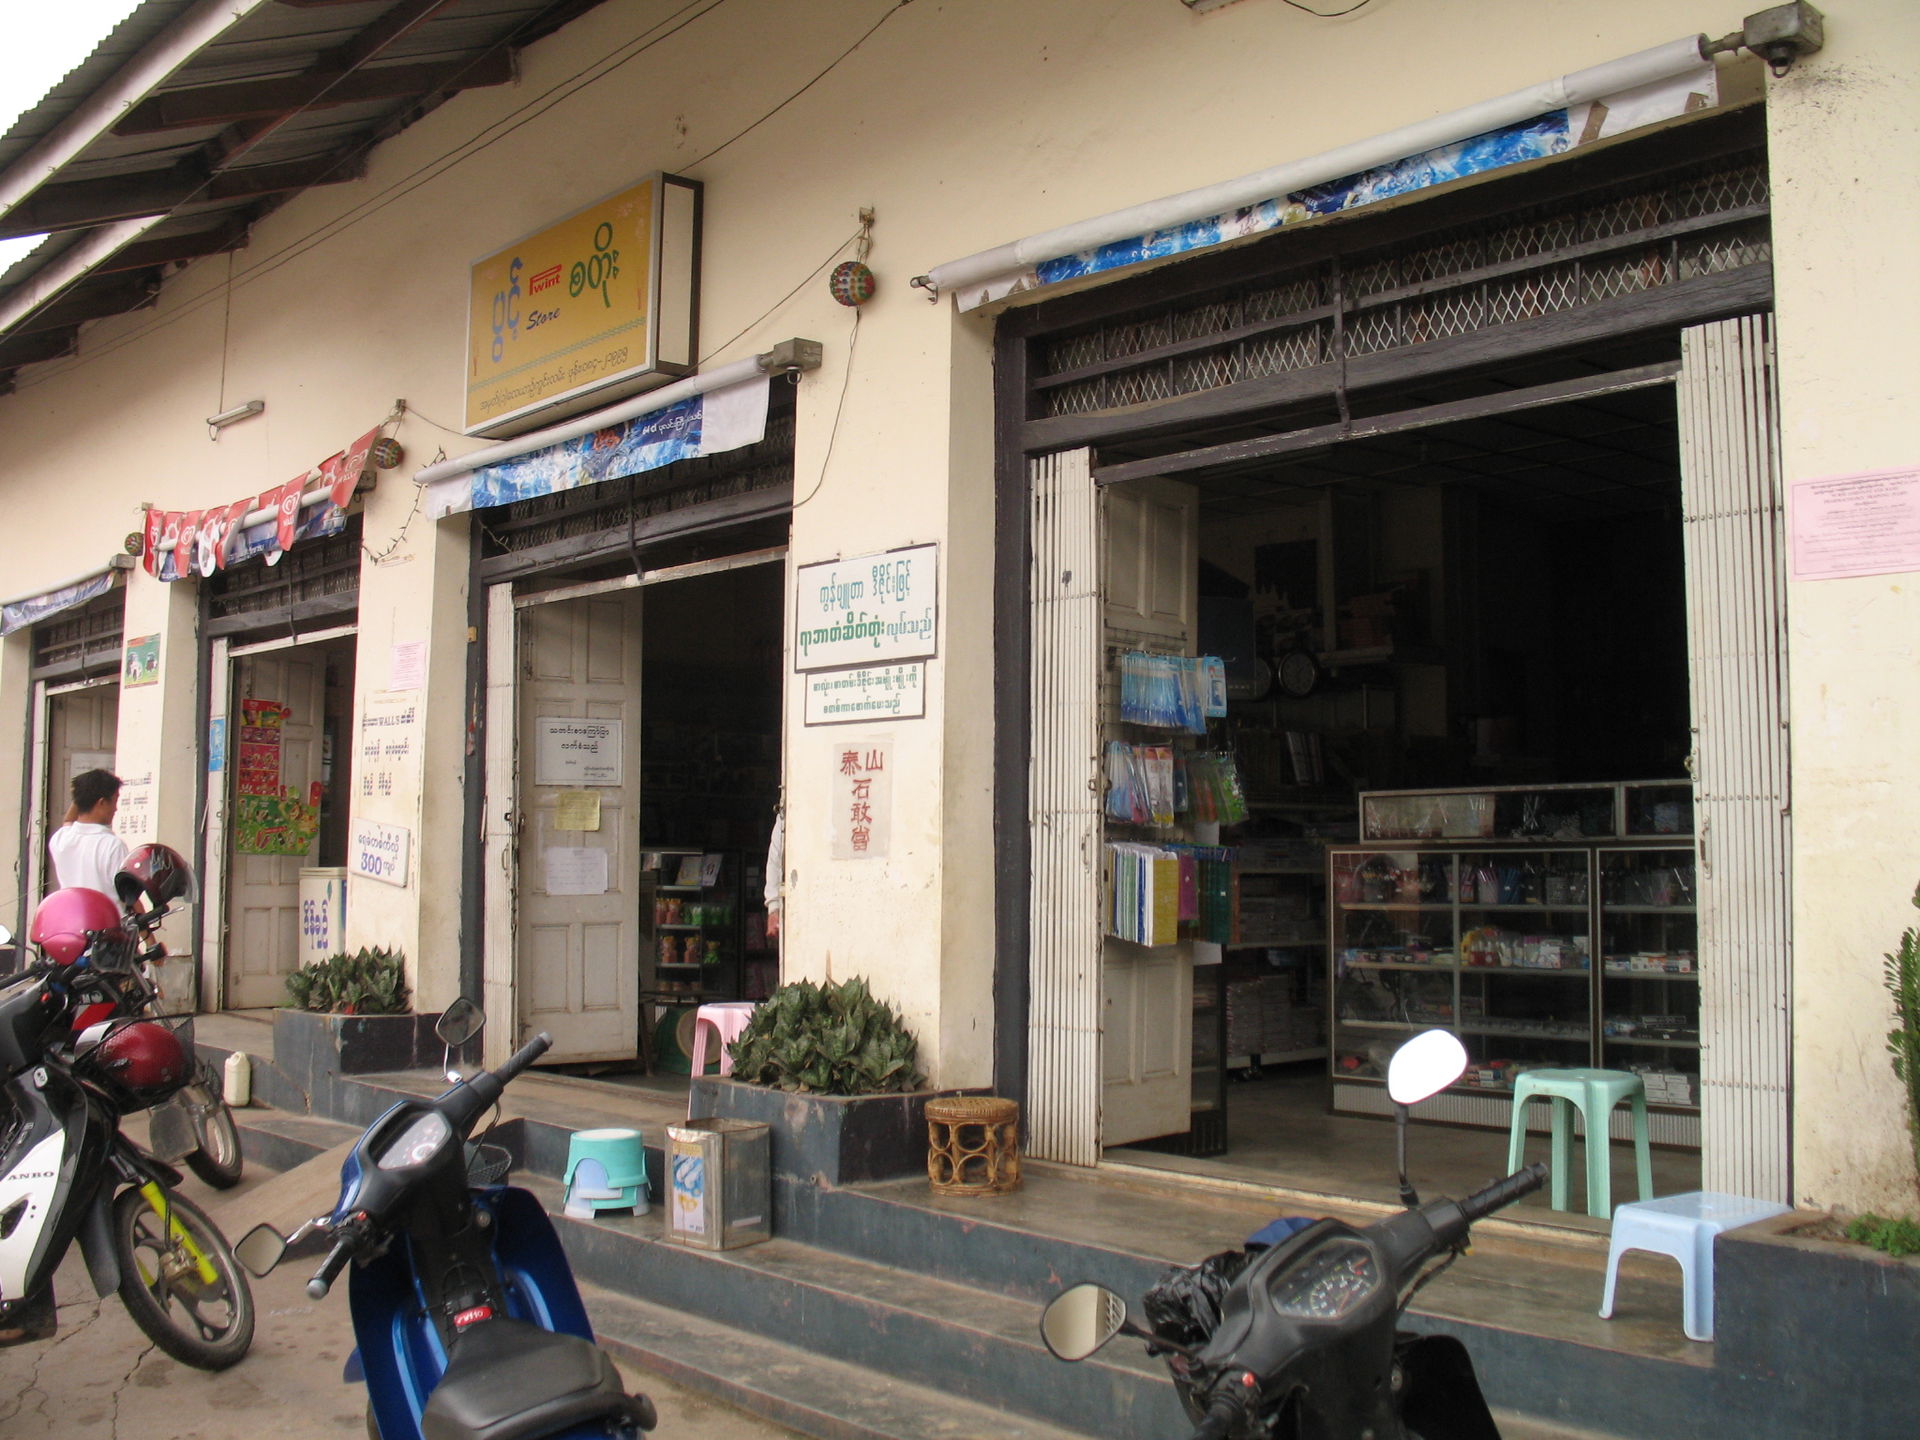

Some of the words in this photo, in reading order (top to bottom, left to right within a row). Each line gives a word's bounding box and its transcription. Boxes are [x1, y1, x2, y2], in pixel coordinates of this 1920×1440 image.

[569, 222, 620, 308] စတိုး
[528, 264, 562, 297] Pwint
[526, 307, 561, 331] Store
[361, 852, 382, 875] 300
